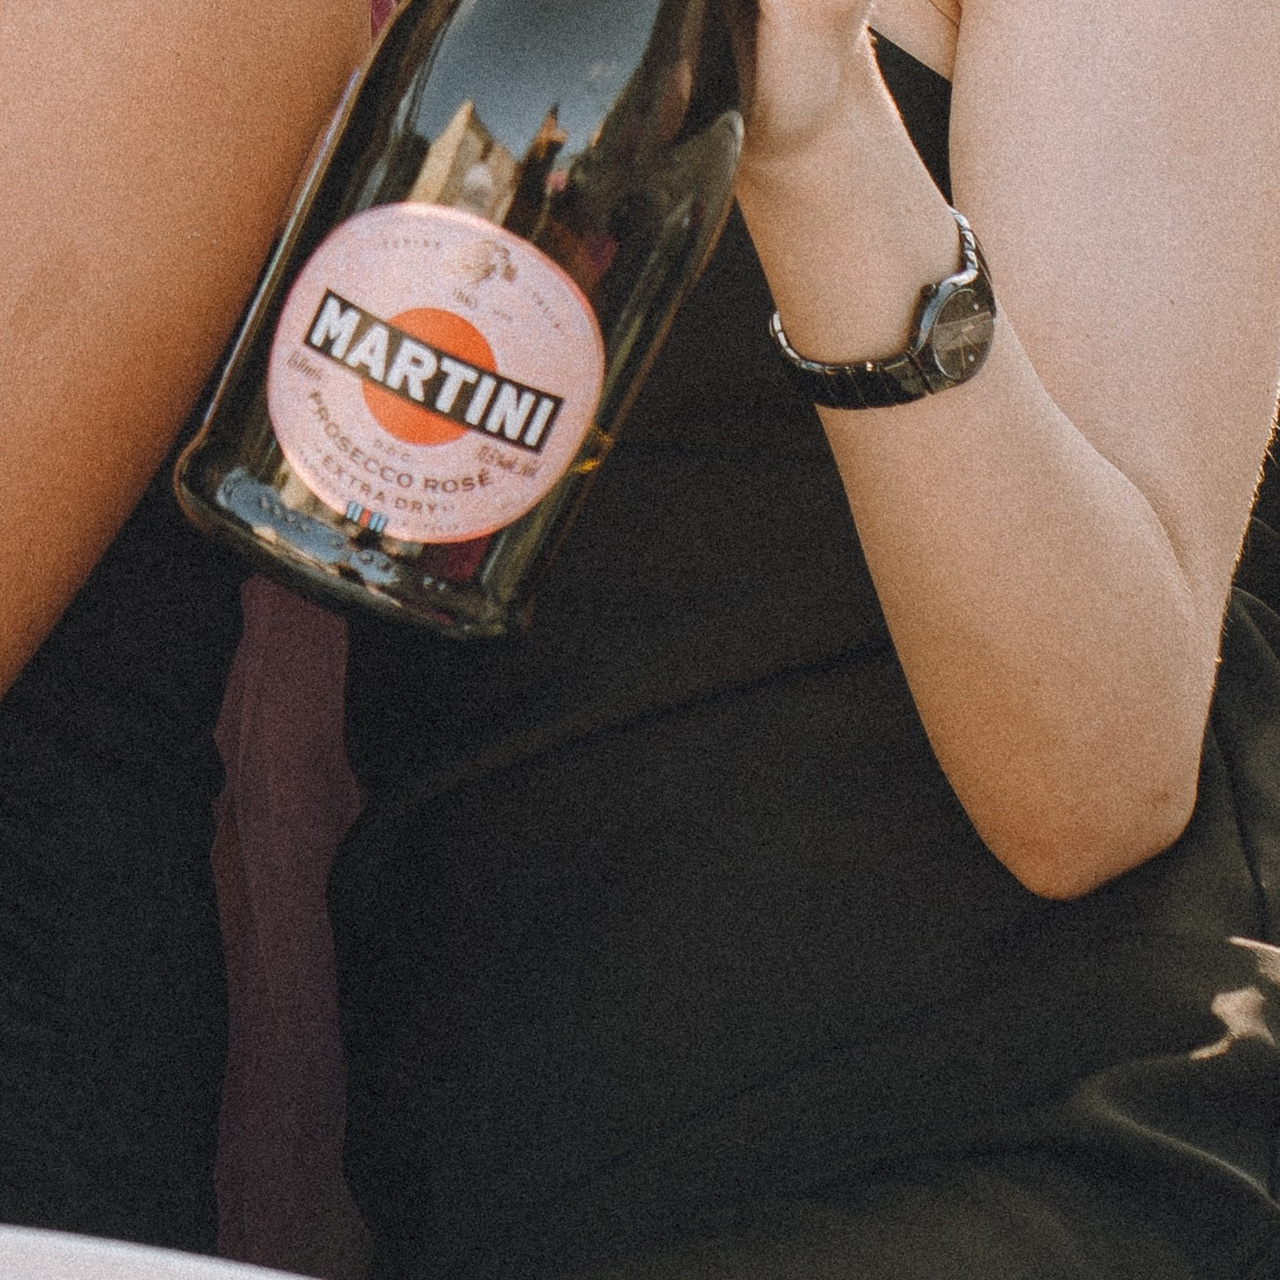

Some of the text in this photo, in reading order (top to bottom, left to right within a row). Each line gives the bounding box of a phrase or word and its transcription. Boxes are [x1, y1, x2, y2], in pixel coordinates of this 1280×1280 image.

[310, 295, 556, 447] MARTINI
[308, 390, 414, 489] PROSECCO
[423, 467, 493, 493] ROSÉ
[322, 454, 387, 502] EXTRA
[394, 498, 437, 515] DRY
